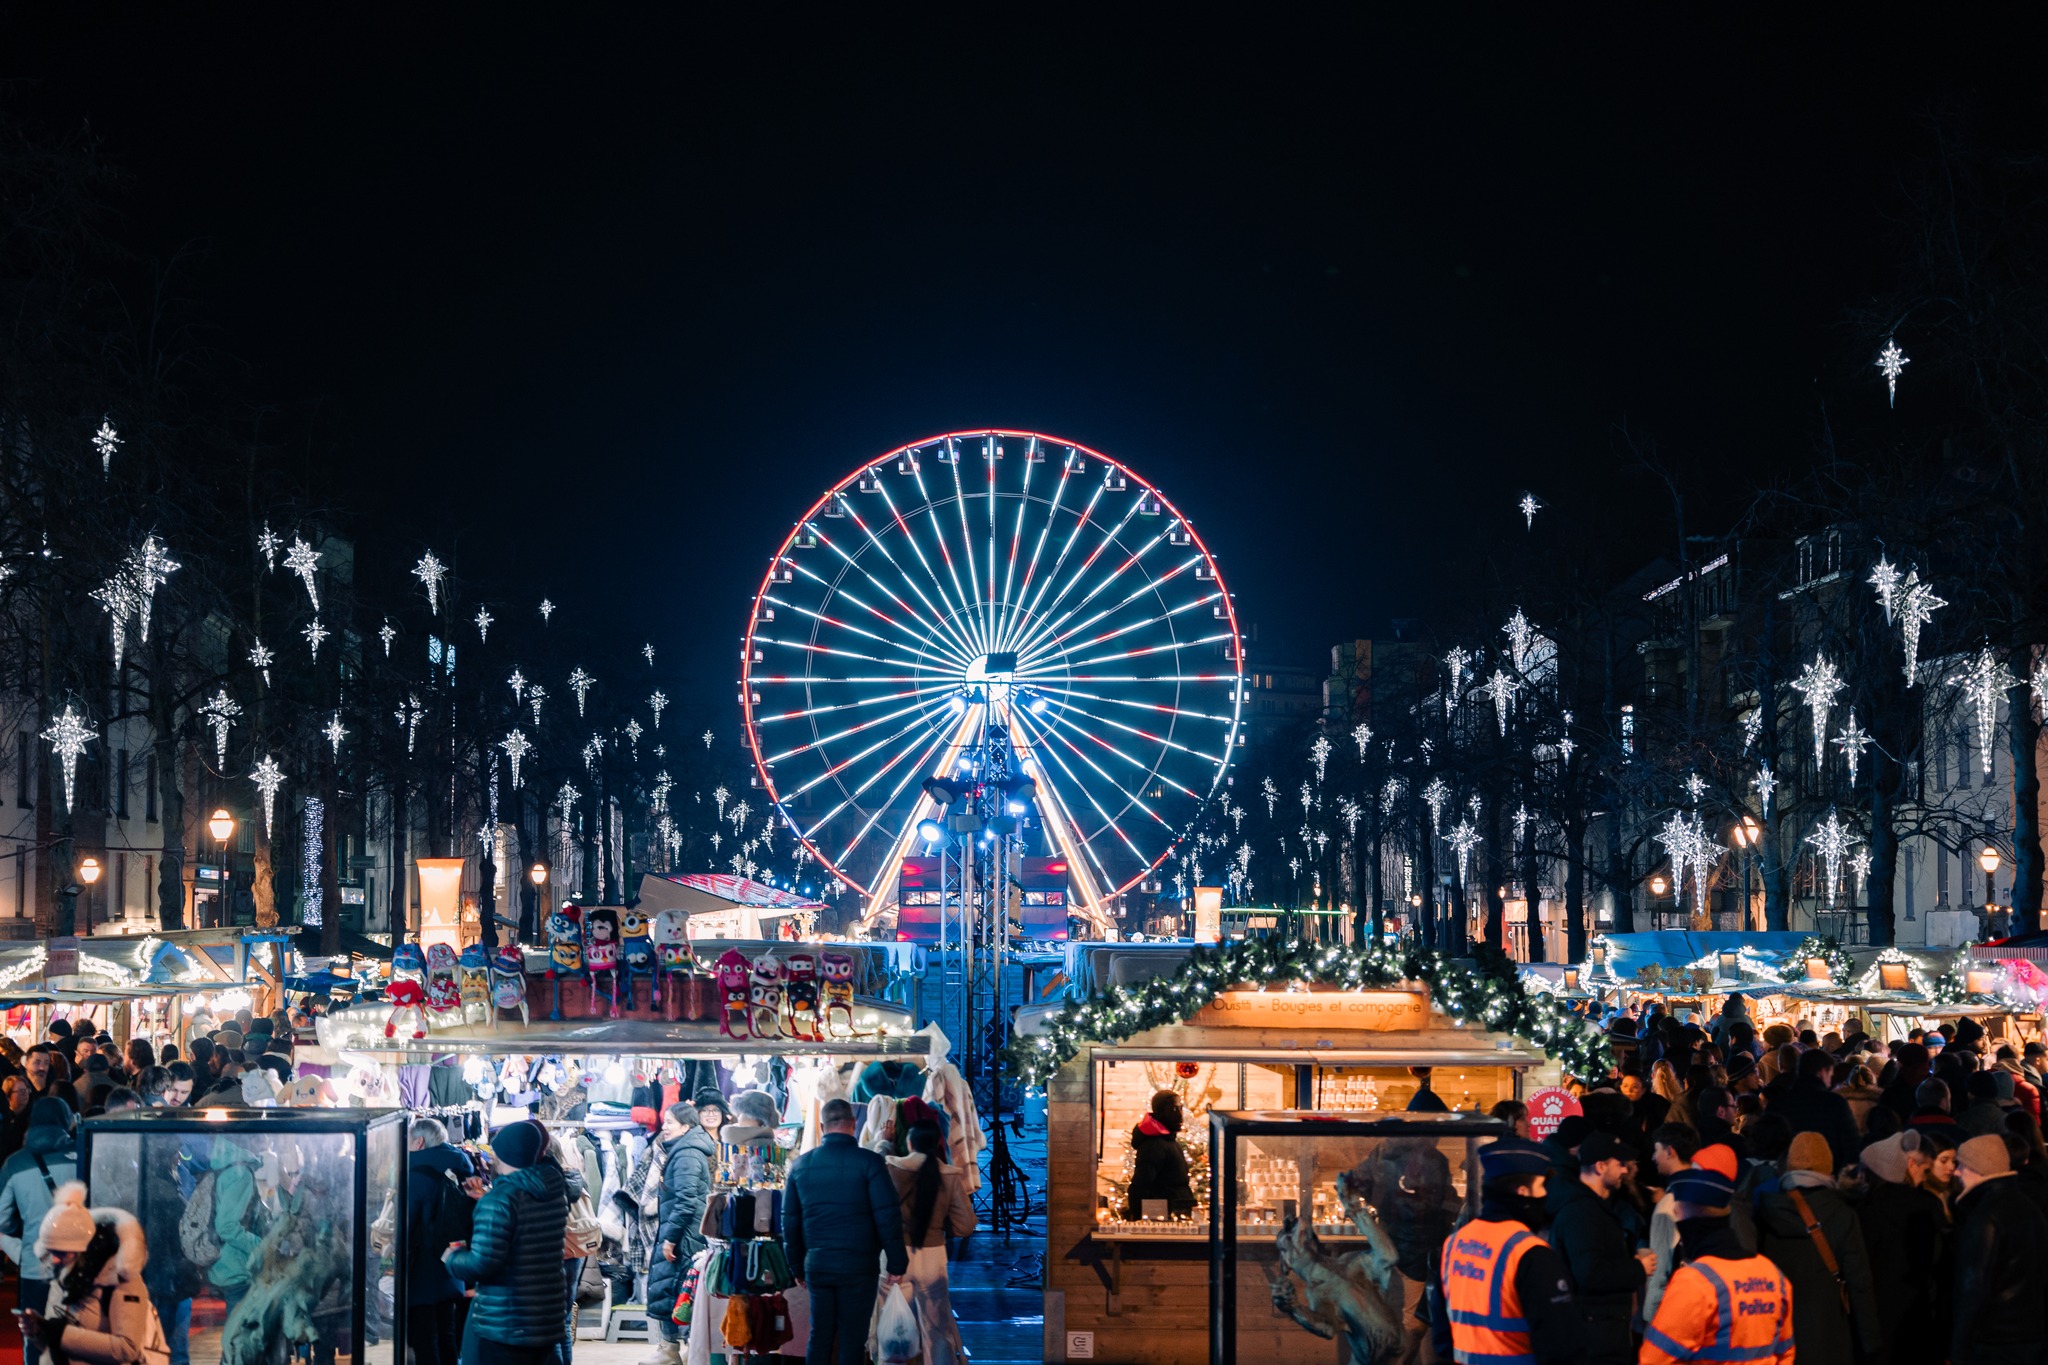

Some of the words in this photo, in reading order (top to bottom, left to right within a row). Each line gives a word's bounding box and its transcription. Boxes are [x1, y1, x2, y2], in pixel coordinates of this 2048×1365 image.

[1272, 998, 1323, 1014] Bougies
[1329, 1000, 1342, 1012] et
[1348, 1001, 1422, 1015] compagnie
[1455, 1238, 1493, 1260] Politie
[1452, 1260, 1486, 1282] Police
[1733, 1277, 1775, 1294] Politie
[1738, 1299, 1775, 1317] Police
